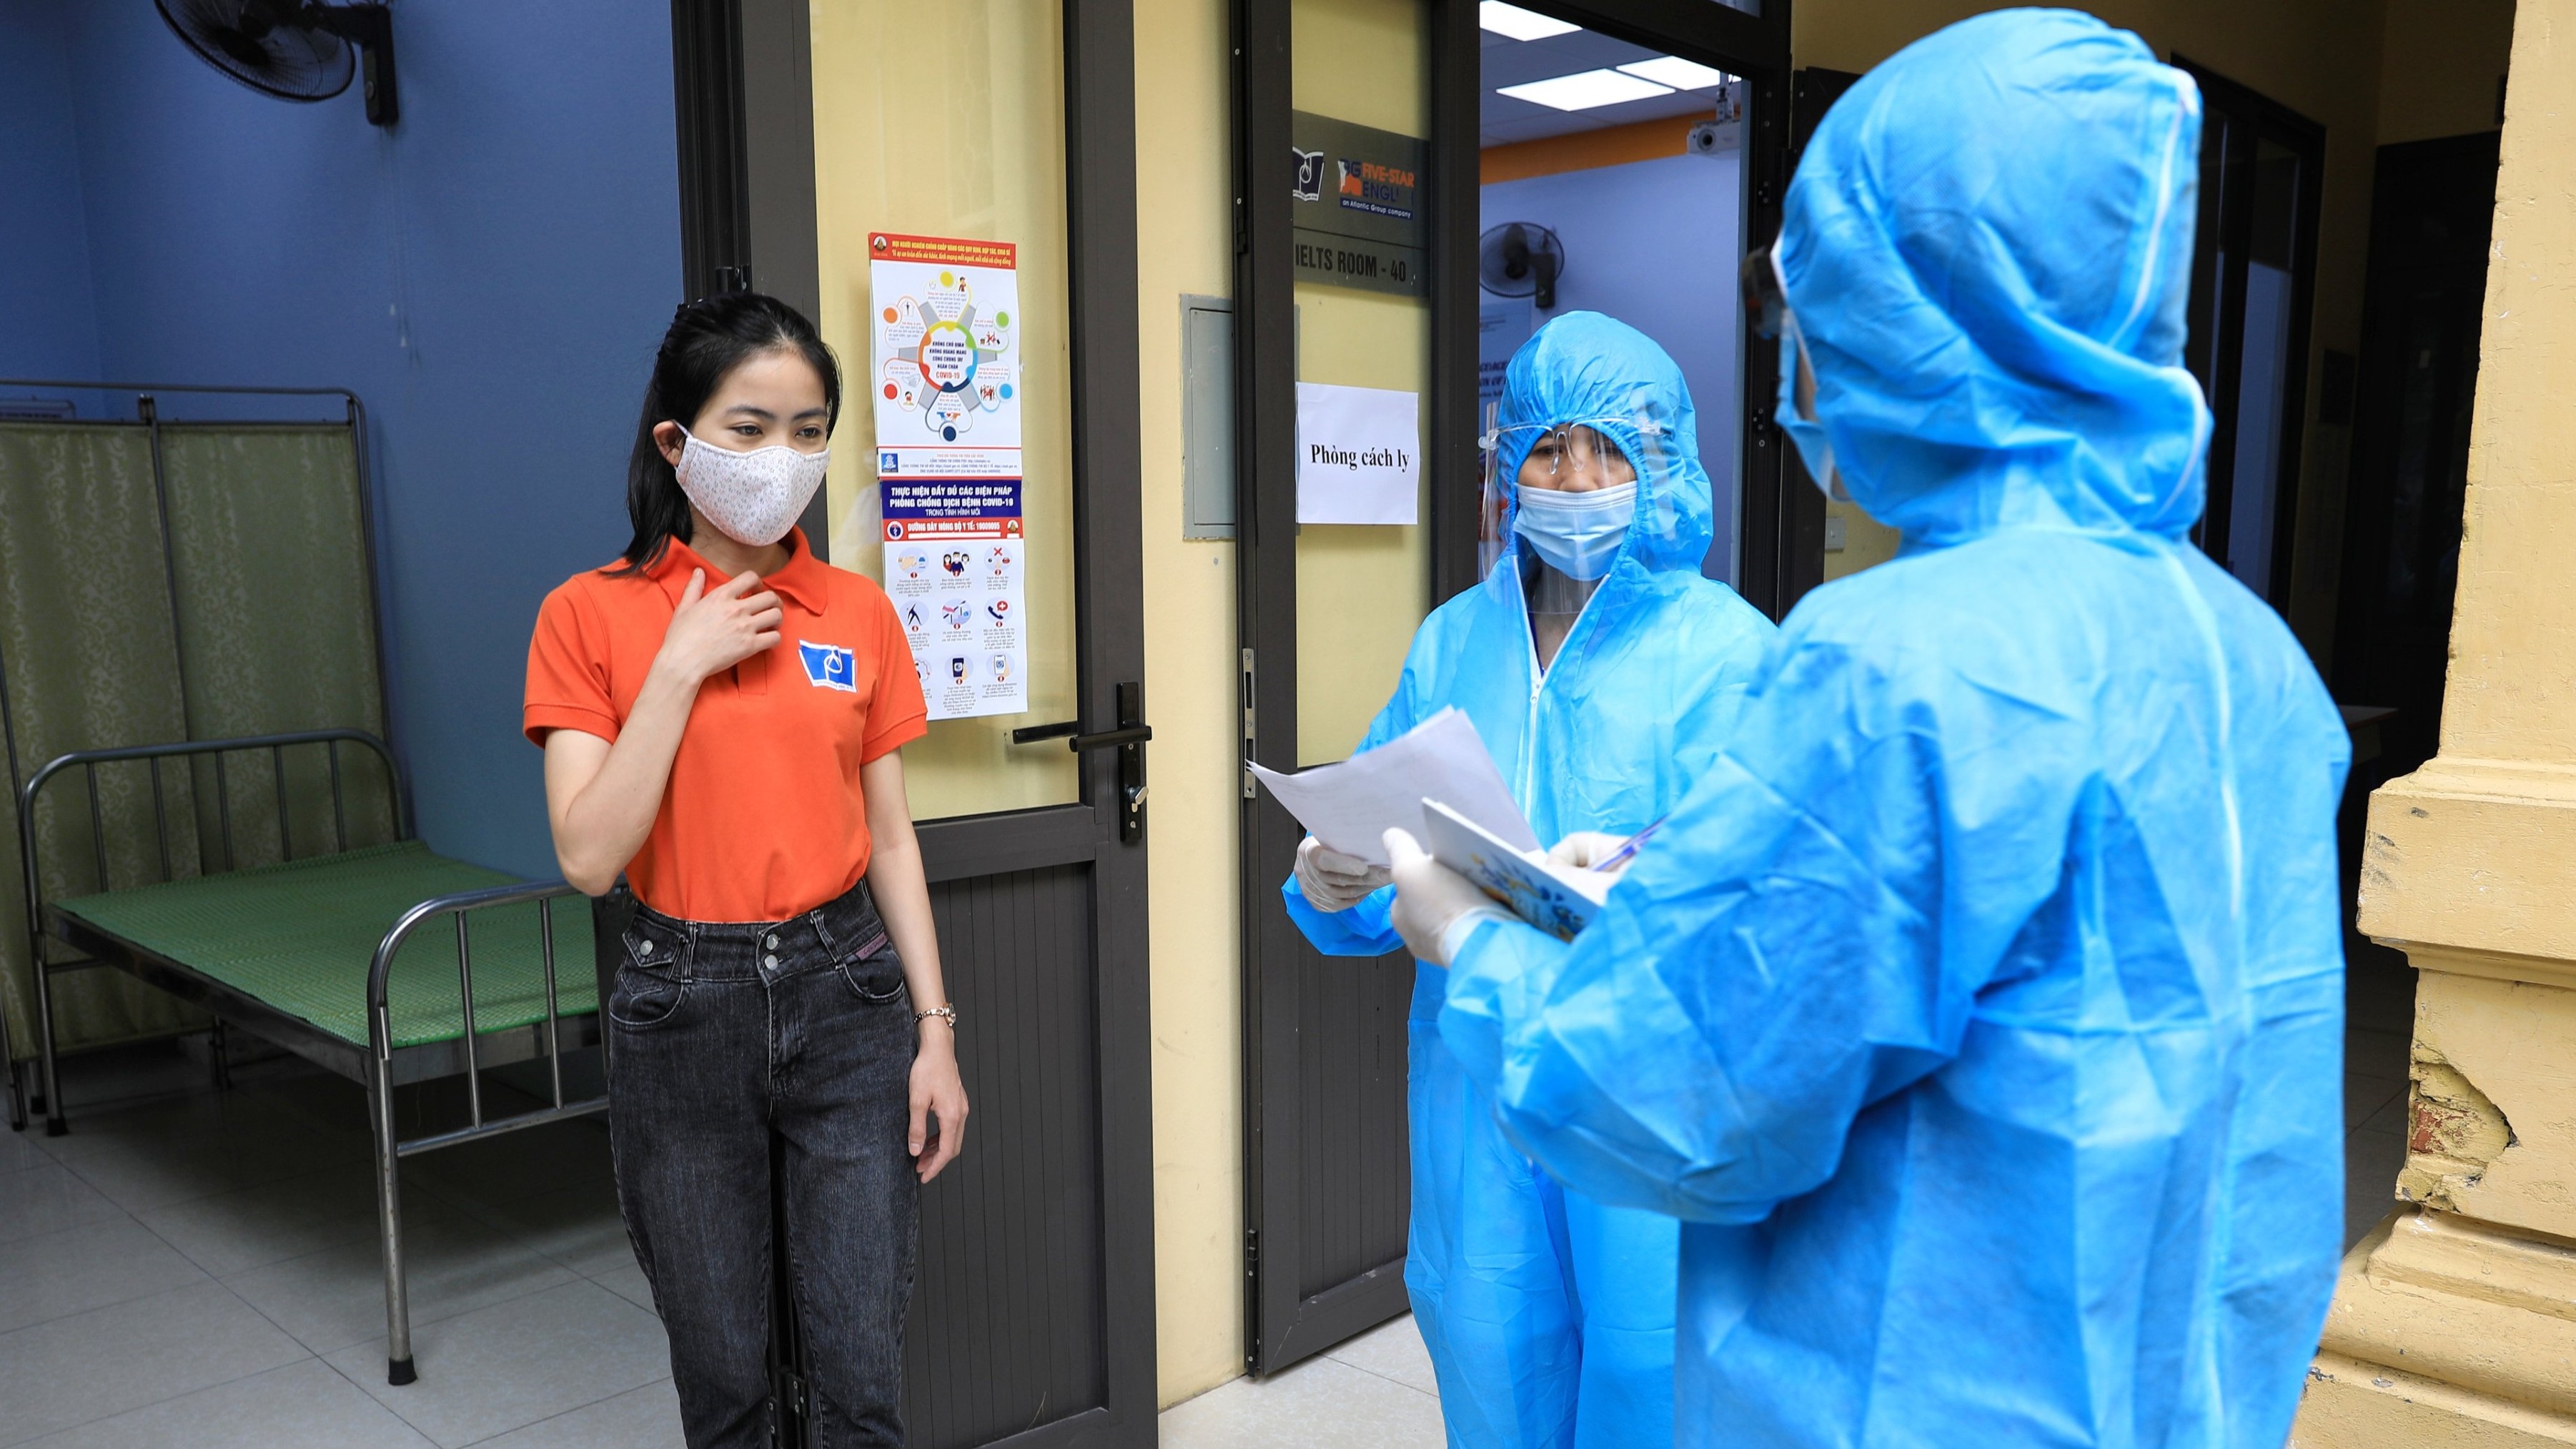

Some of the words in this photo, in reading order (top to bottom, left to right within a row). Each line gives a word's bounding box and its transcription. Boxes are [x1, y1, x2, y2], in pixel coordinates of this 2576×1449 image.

[1362, 162, 1415, 188] FIVE-STAR
[1350, 201, 1369, 210] Atlantic
[1371, 204, 1386, 214] Group
[1387, 209, 1411, 218] company
[1295, 244, 1333, 271] IELTS
[1338, 251, 1377, 277] ROOM
[1391, 260, 1407, 282] 40
[1311, 444, 1358, 471] Phòng
[1362, 447, 1393, 467] cách
[1397, 449, 1410, 473] ly
[891, 487, 911, 497] THỰC
[912, 485, 930, 498] HIỆN
[959, 485, 974, 495] CÁC
[975, 485, 992, 497] BIỆN
[994, 485, 1012, 495] PHÁP
[916, 495, 941, 507] CHỐNG
[962, 497, 981, 508] BỆNH
